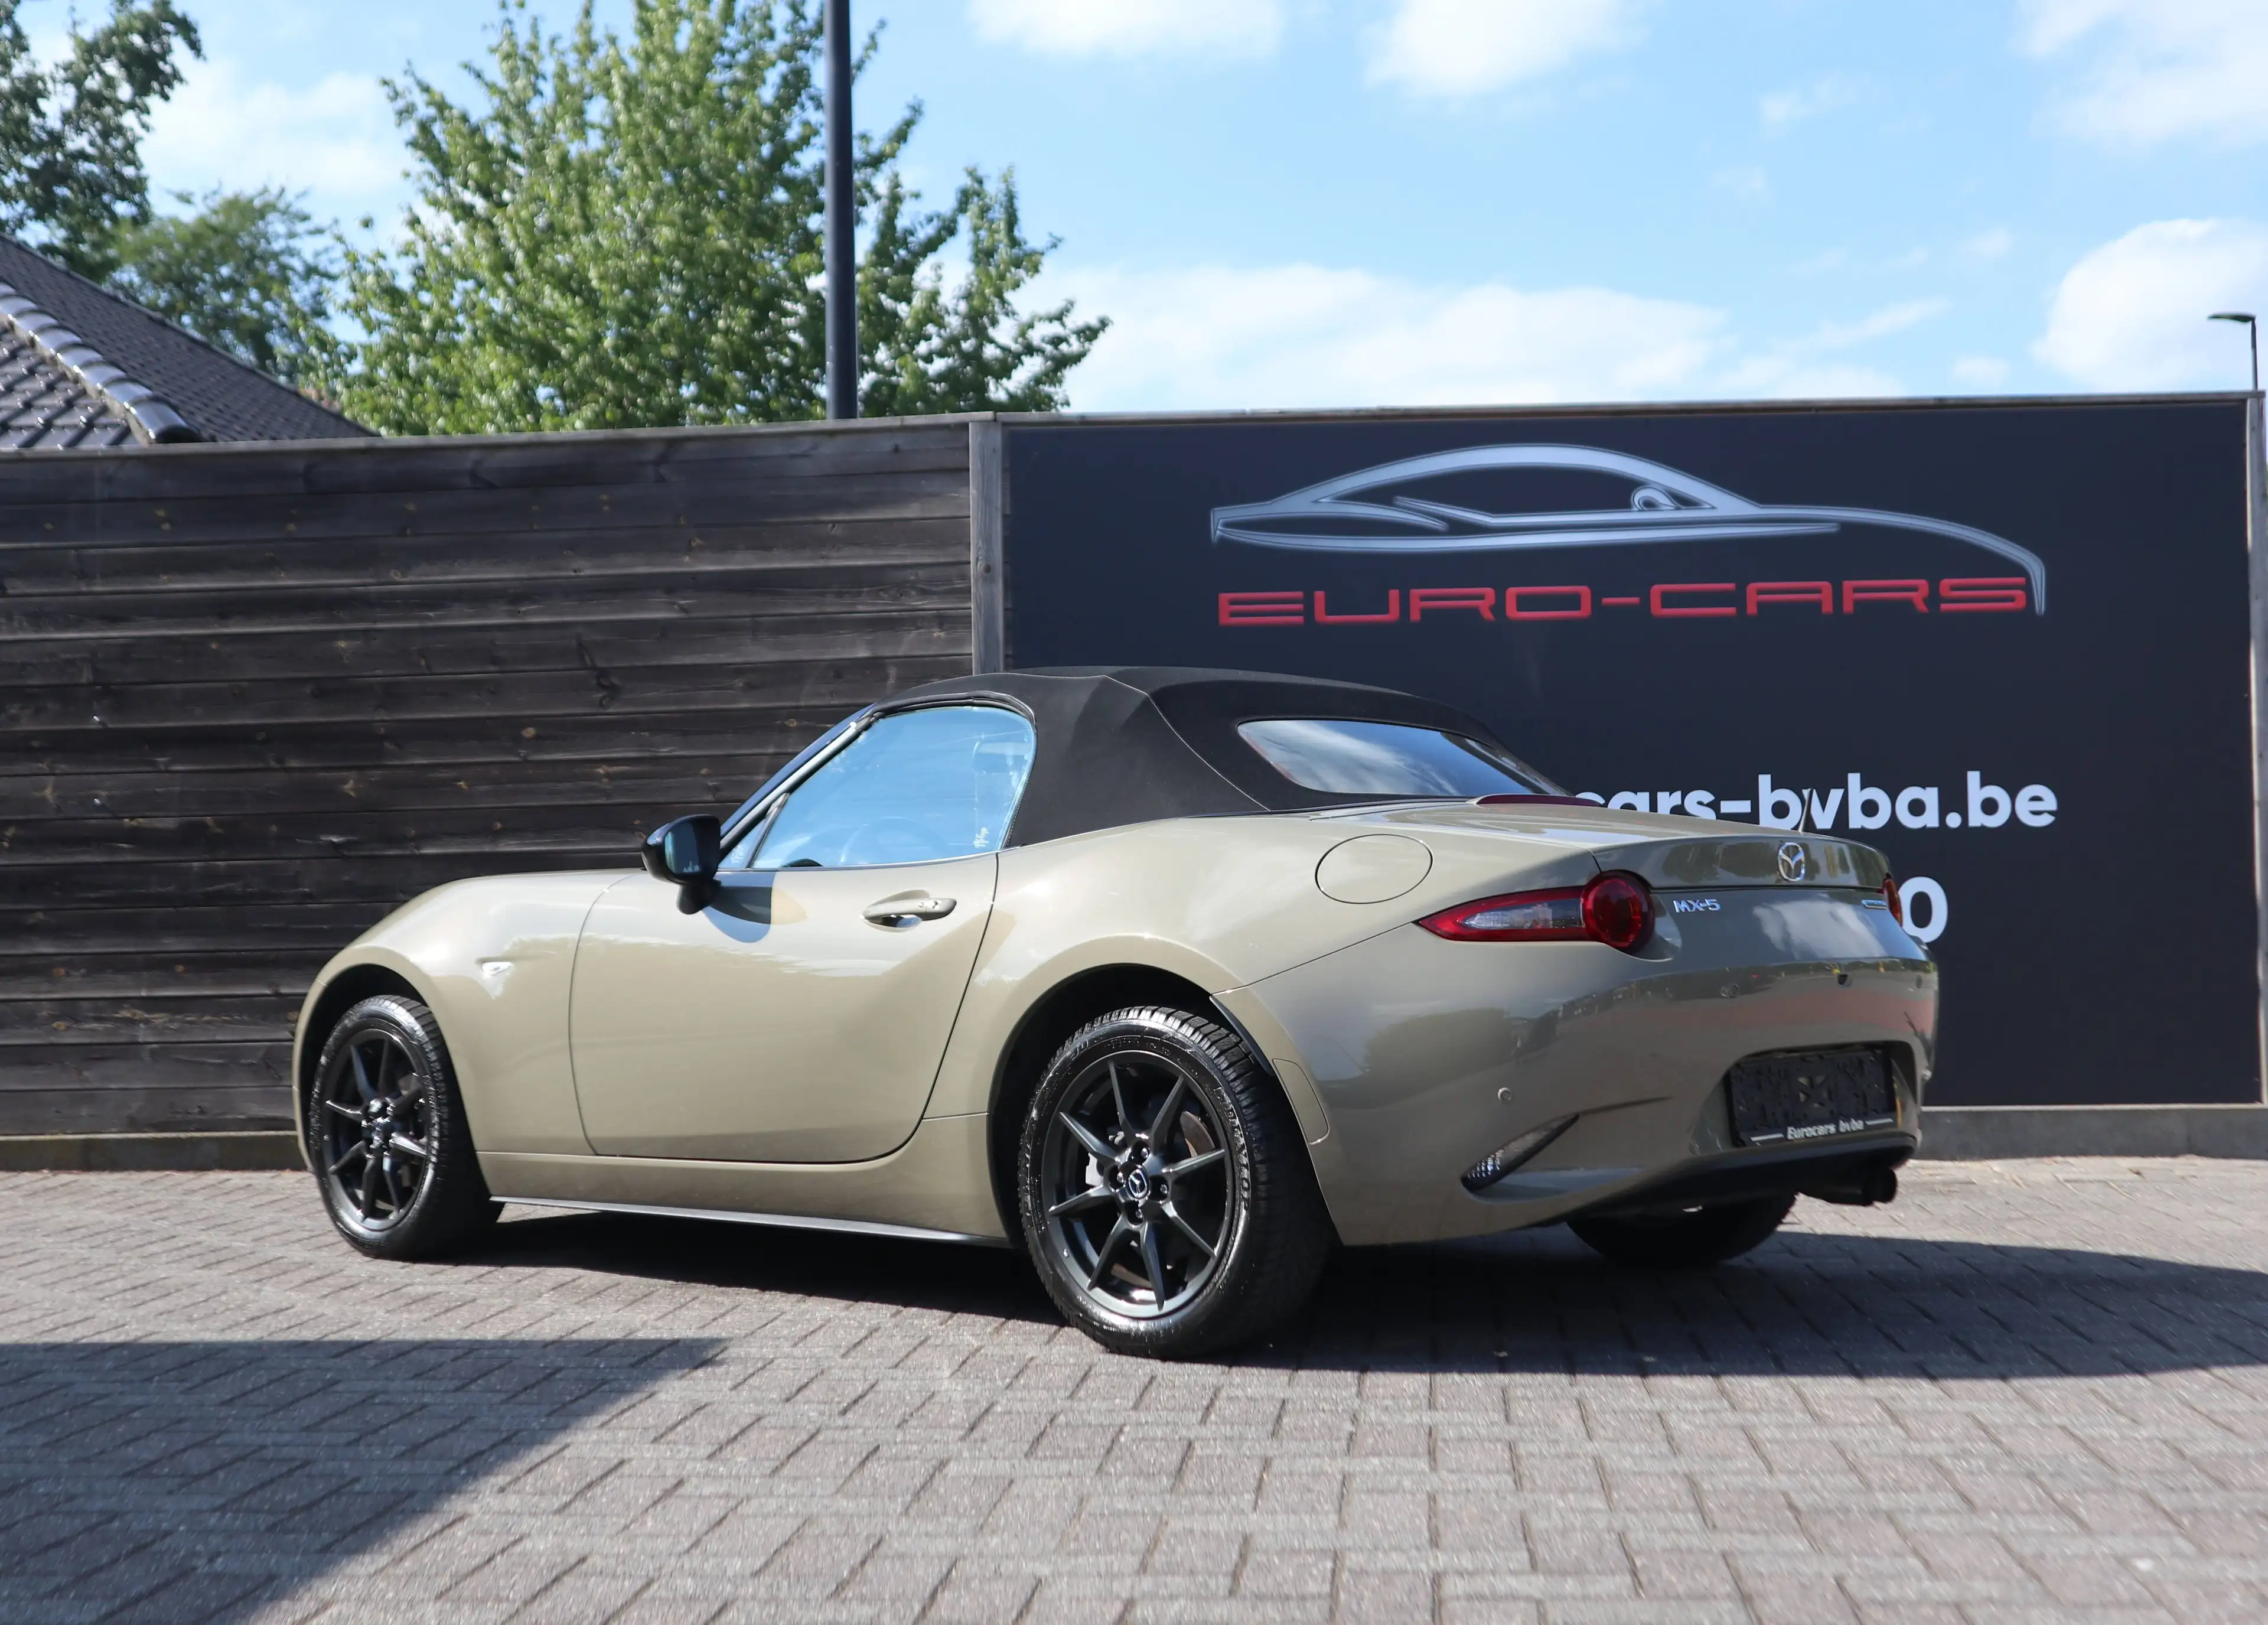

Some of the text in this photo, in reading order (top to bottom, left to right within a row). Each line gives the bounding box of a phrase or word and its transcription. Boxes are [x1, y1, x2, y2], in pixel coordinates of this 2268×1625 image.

[1218, 577, 2026, 627] EURO-CARS
[1576, 771, 2058, 829] ars-bvba.be
[1673, 898, 1721, 913] MX-5
